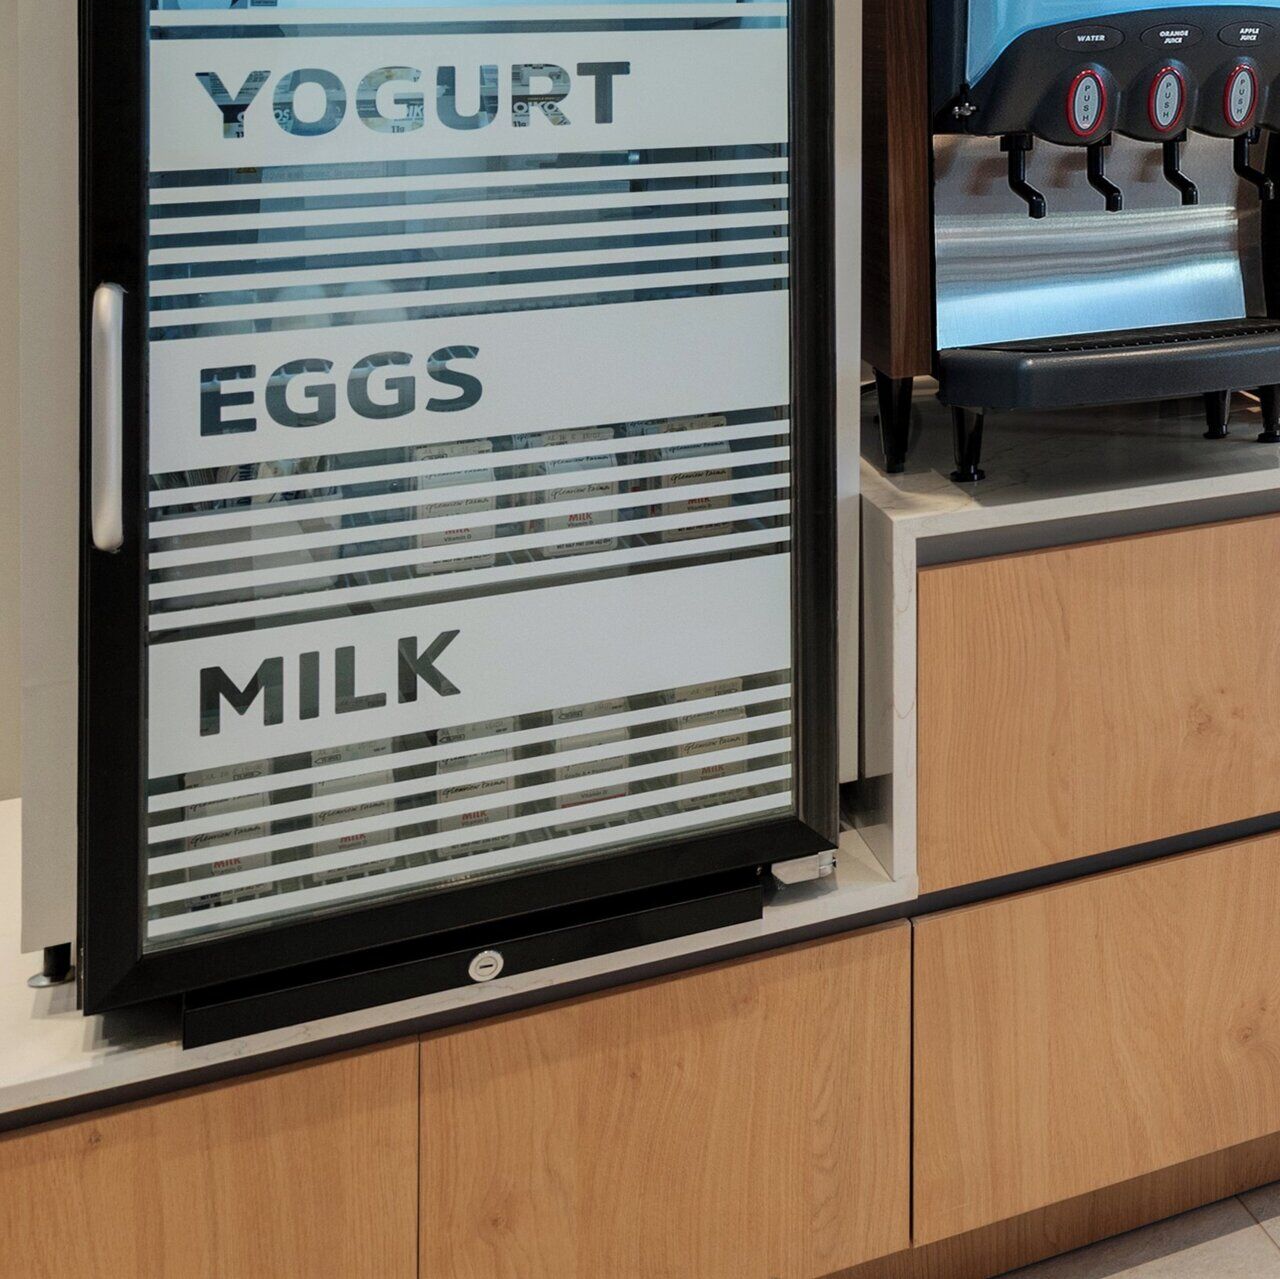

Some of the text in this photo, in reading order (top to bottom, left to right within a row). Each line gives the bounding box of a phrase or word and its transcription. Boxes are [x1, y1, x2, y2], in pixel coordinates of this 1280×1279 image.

[1077, 34, 1106, 42] WATER
[1159, 29, 1189, 38] ORANGE
[1163, 36, 1183, 44] JUICE
[195, 61, 631, 139] YOGURT
[1082, 85, 1092, 122] PUSH
[1162, 82, 1173, 119] PUSH
[1236, 79, 1247, 115] PUSH
[200, 345, 484, 437] EGGS
[568, 511, 593, 522] MILK
[200, 629, 461, 737] MILK
